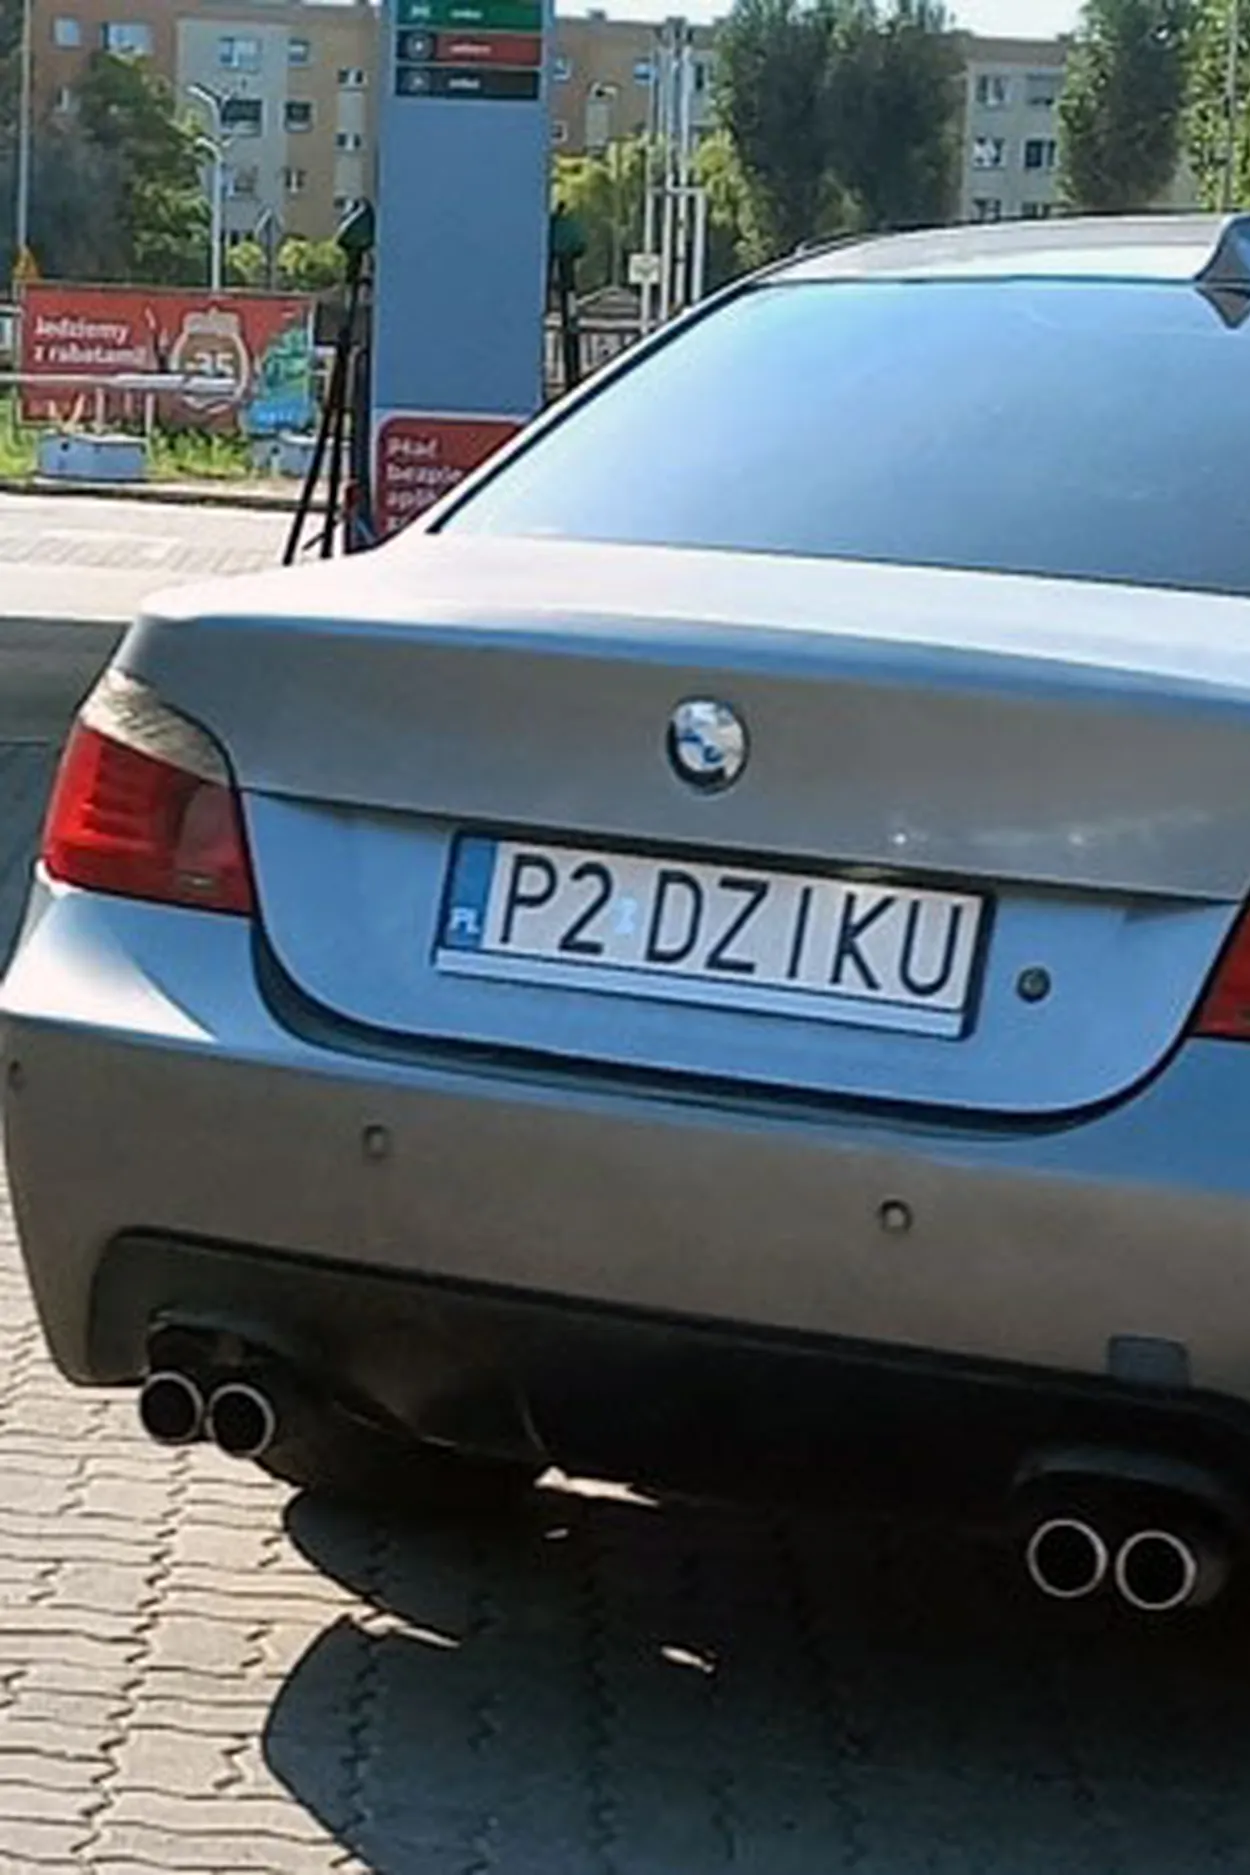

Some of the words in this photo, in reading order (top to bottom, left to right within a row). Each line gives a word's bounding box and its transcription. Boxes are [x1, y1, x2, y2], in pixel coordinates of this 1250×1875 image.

[451, 907, 481, 934] PL
[500, 854, 612, 953] P2
[644, 870, 962, 997] DZIKU
